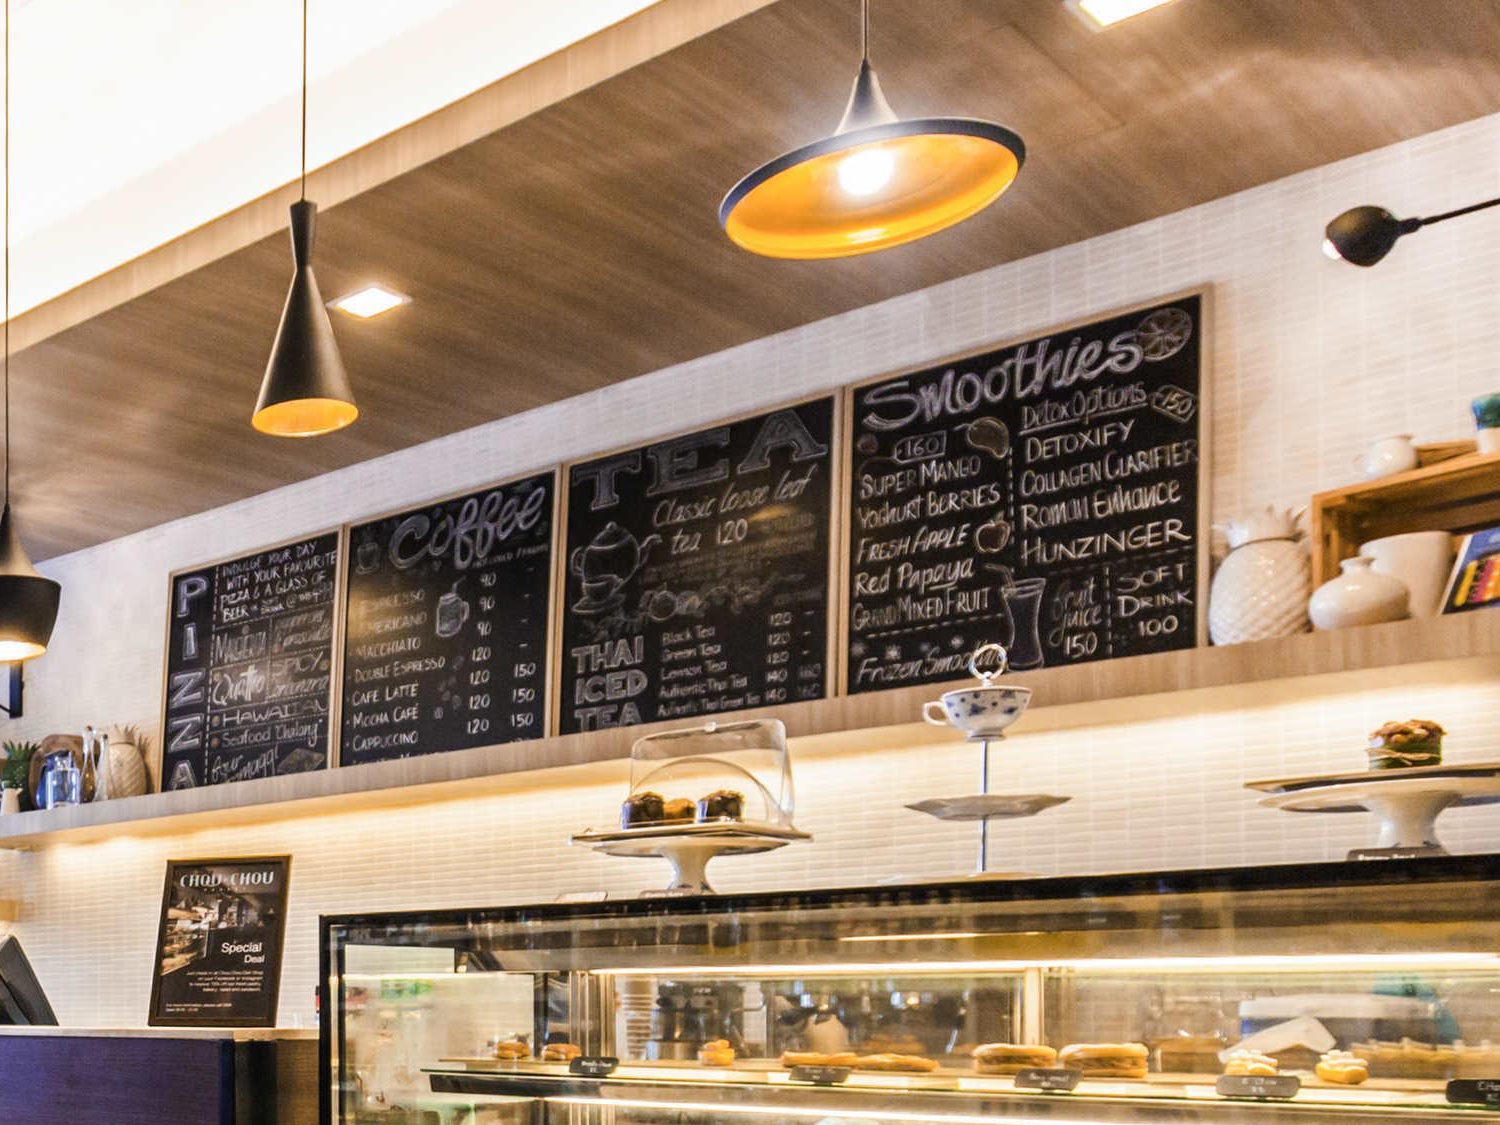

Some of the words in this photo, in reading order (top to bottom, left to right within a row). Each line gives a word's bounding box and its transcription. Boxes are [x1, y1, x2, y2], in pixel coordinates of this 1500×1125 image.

[863, 331, 1143, 432] Smoothies
[1161, 391, 1193, 415] 150
[906, 437, 940, 457] 160
[1026, 418, 1136, 463] DETOXIFY
[573, 408, 829, 511] TEA
[1021, 461, 1102, 497] COLLAGEN
[1104, 439, 1198, 480] CLARIFIER
[860, 468, 918, 499] SUPER
[921, 455, 982, 487] MANGO
[389, 486, 546, 570] Coffee
[716, 518, 748, 546] 120
[296, 541, 318, 558] DAY
[857, 535, 911, 565] FRESH
[911, 523, 971, 553] APPLE
[1021, 518, 1192, 567] HUNZINGER
[220, 588, 251, 612] PIZZA
[264, 583, 273, 597] A
[275, 574, 309, 595] GLASS
[311, 570, 327, 585] OF
[227, 571, 250, 591] WITH
[254, 566, 281, 583] YOUR
[855, 566, 891, 598] Red
[898, 558, 975, 595] Papaya
[1116, 563, 1188, 592] SOFT
[222, 604, 250, 623] BEER
[899, 595, 943, 620] MIXED
[945, 585, 991, 615] FRUIT
[1117, 590, 1193, 617] DRINK
[694, 625, 715, 639] Tea
[1139, 615, 1179, 637] 100
[571, 635, 644, 674] THAI
[700, 643, 722, 656] Tea
[1065, 631, 1098, 658] 150
[394, 656, 446, 677] ESPRESSO
[472, 646, 492, 662] 120
[470, 669, 490, 685] 120
[514, 662, 537, 678] 150
[705, 660, 728, 673] Tea
[856, 657, 923, 684] Frozen
[469, 694, 491, 710] 120
[512, 688, 535, 703] 150
[575, 669, 648, 705] ICED
[574, 702, 642, 732] TEA
[222, 727, 271, 748] Seafood
[352, 731, 419, 751] CAPPUCCINO
[467, 719, 490, 734] 120
[511, 712, 534, 728] 150
[180, 873, 222, 888] CHOU
[231, 871, 274, 886] CHOU
[221, 942, 262, 955] Special
[244, 954, 265, 964] Deal
